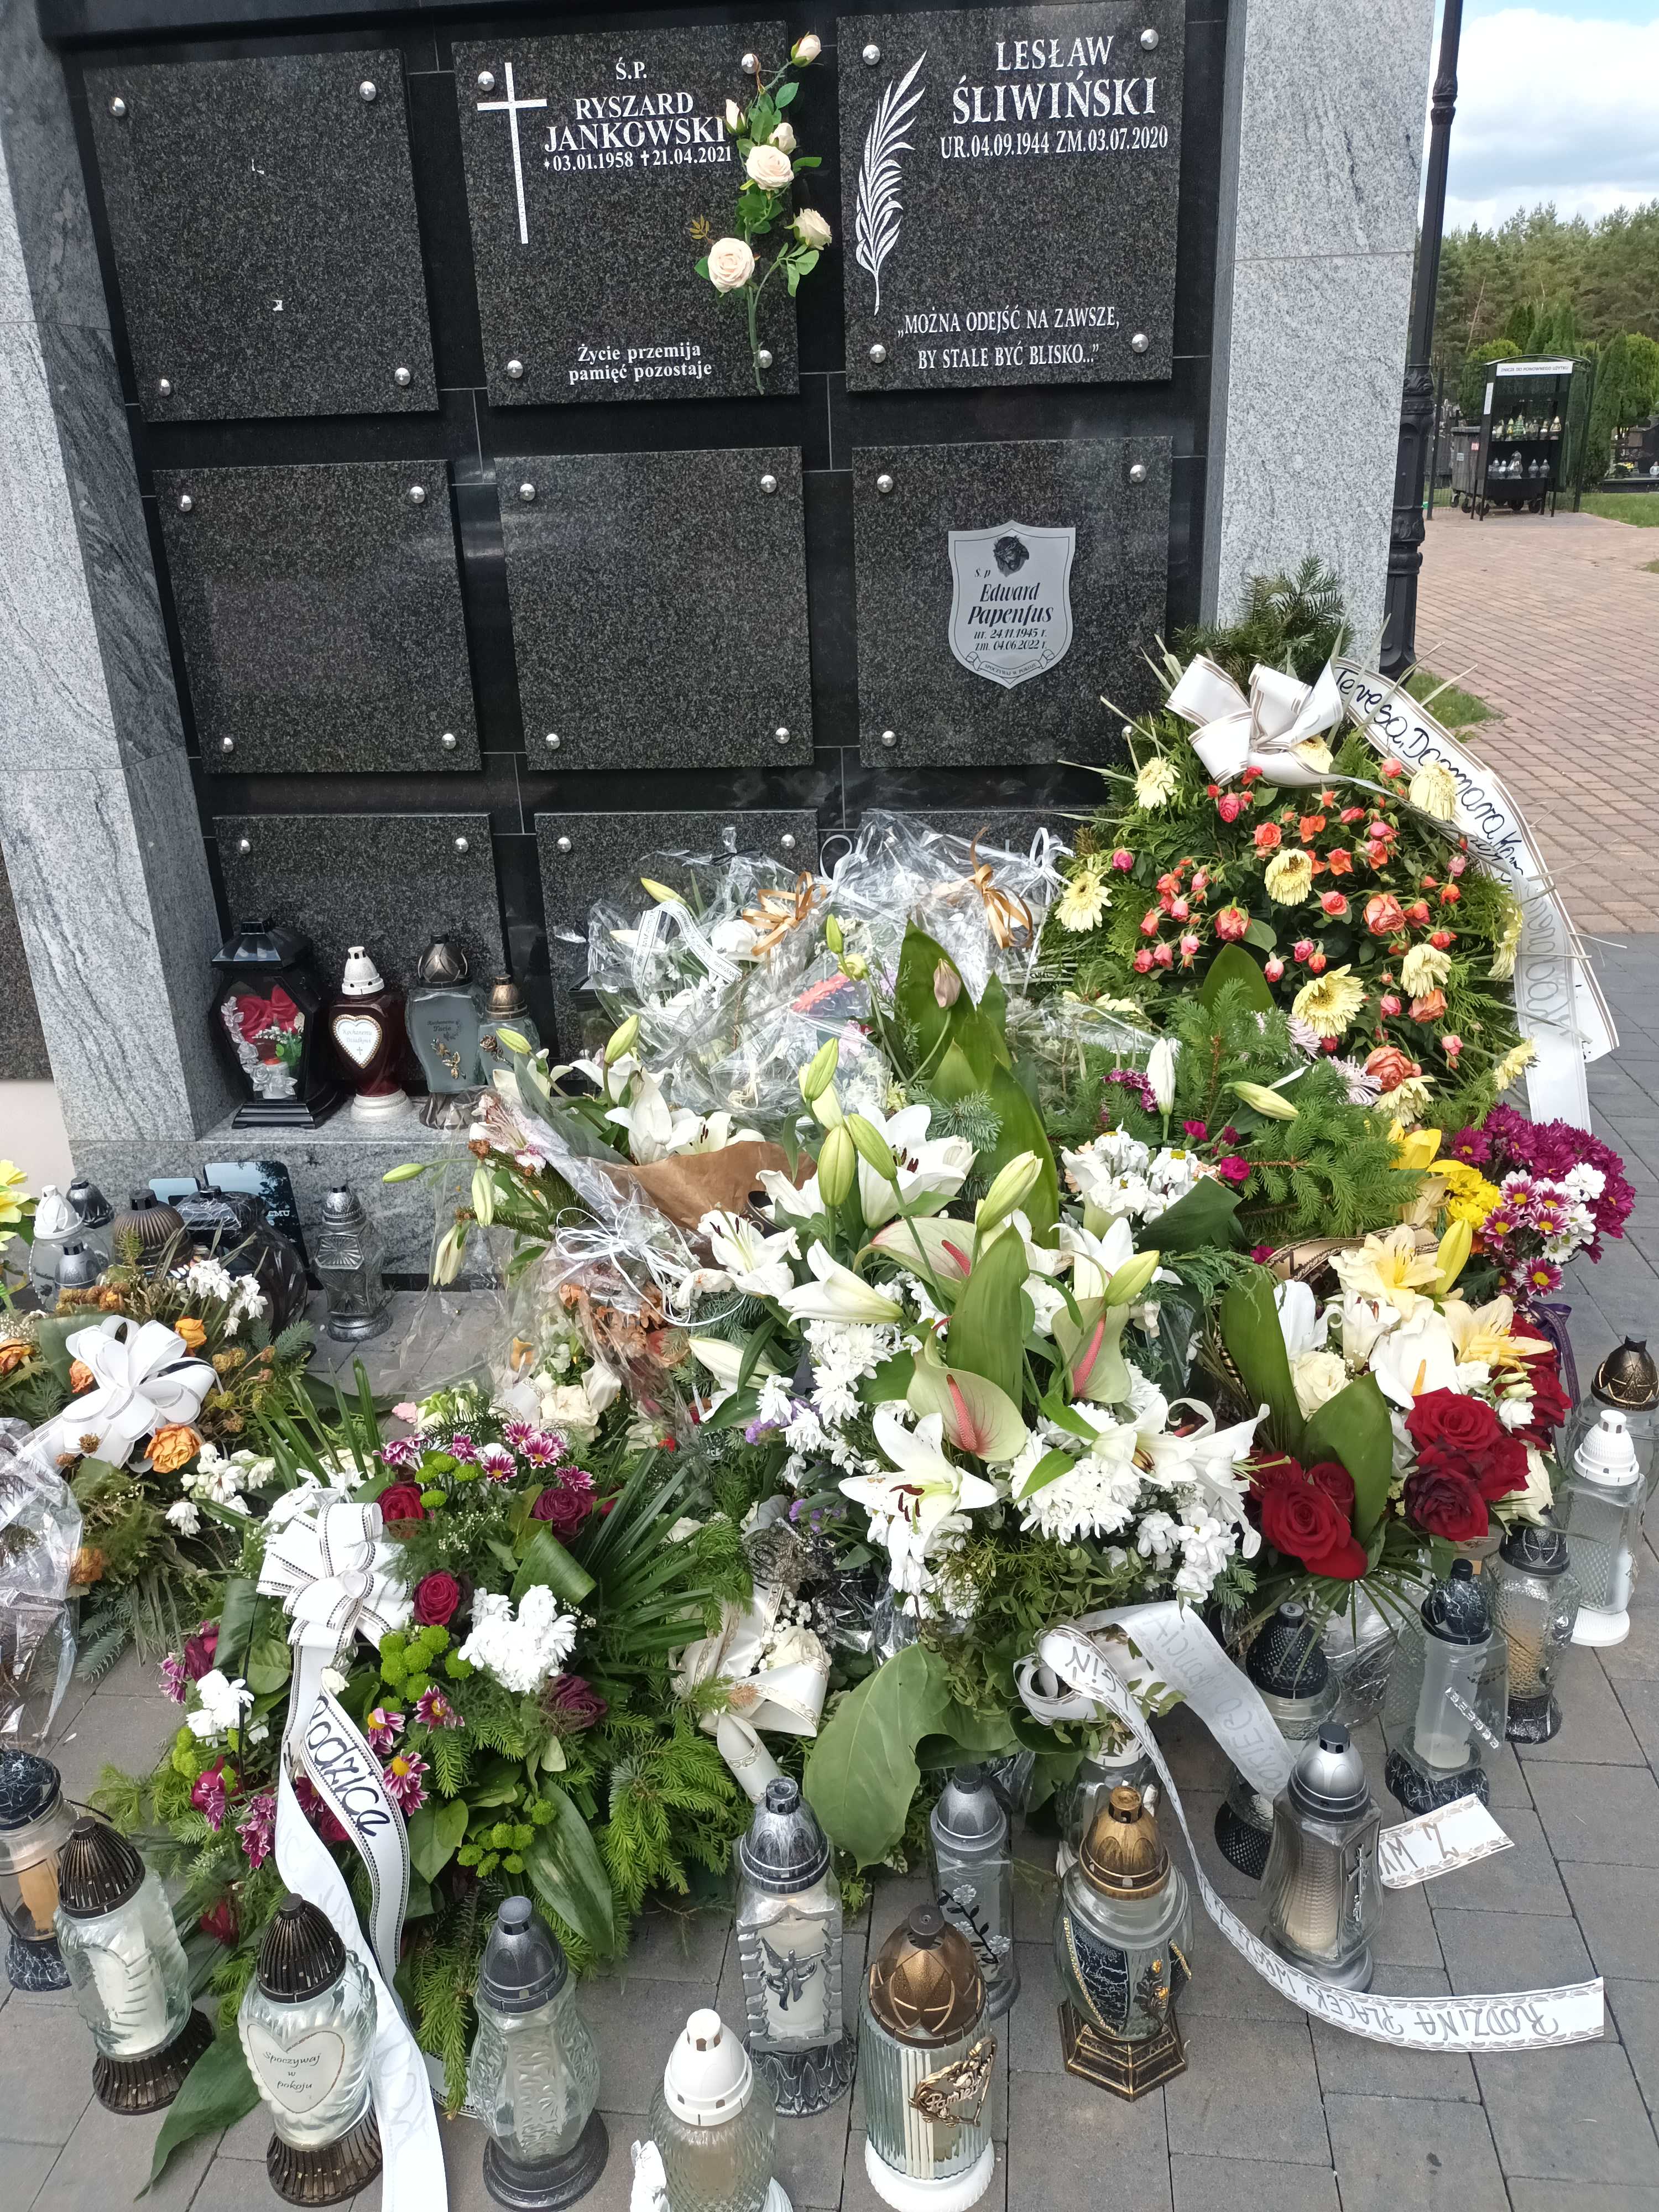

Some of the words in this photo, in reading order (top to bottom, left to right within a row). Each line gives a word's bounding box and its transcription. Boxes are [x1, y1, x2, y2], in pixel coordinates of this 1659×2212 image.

[995, 35, 1114, 71] LESŁAW
[615, 57, 647, 80] Ś.P.
[575, 92, 694, 121] RYSZARD
[953, 71, 1157, 124] ŚLIWIŃSKI
[544, 116, 729, 153] JANKOWSKI
[940, 132, 1050, 159] UR.04.09.1944
[1056, 125, 1168, 153] ZM.03.07.2020
[966, 305, 1020, 334] ODEJŚĆ
[1026, 310, 1049, 329] NA
[1054, 306, 1120, 329] ZAWSZE,
[578, 343, 620, 363] Życie
[628, 342, 701, 364] przemija
[918, 350, 937, 369] BY
[942, 347, 989, 368] STALE
[994, 341, 1023, 366] BYĆ
[568, 364, 628, 385] pamięć
[634, 359, 712, 380] pozostaje
[979, 582, 1041, 602] Edward
[967, 604, 1054, 628] Papenfus
[974, 630, 987, 639] ur.
[989, 628, 1039, 639] 24.11.1945
[993, 639, 1040, 651] 04.06.2022
[1306, 1984, 1404, 2036] PLACEK
[1414, 2002, 1559, 2041] RODZINA
[263, 2051, 321, 2068] Spoczywaj
[277, 2080, 313, 2093] pokoju
